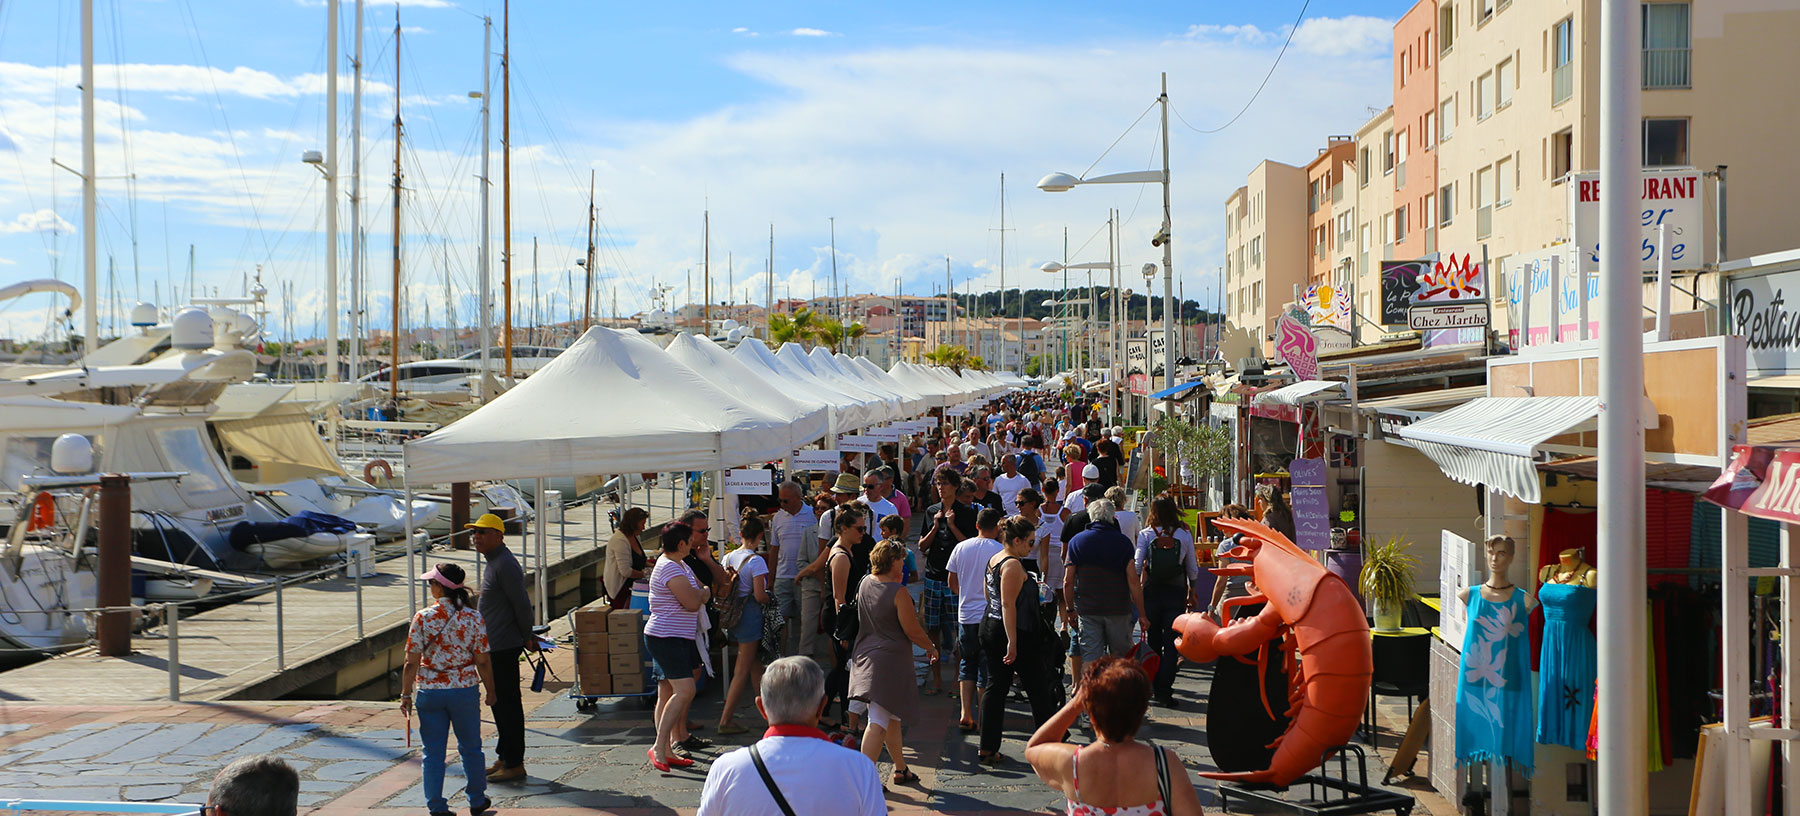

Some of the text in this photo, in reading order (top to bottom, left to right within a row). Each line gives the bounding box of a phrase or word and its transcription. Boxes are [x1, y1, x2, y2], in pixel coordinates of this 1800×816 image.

[1413, 314, 1486, 328] Chez Marthe
[1734, 288, 1800, 349] Restau
